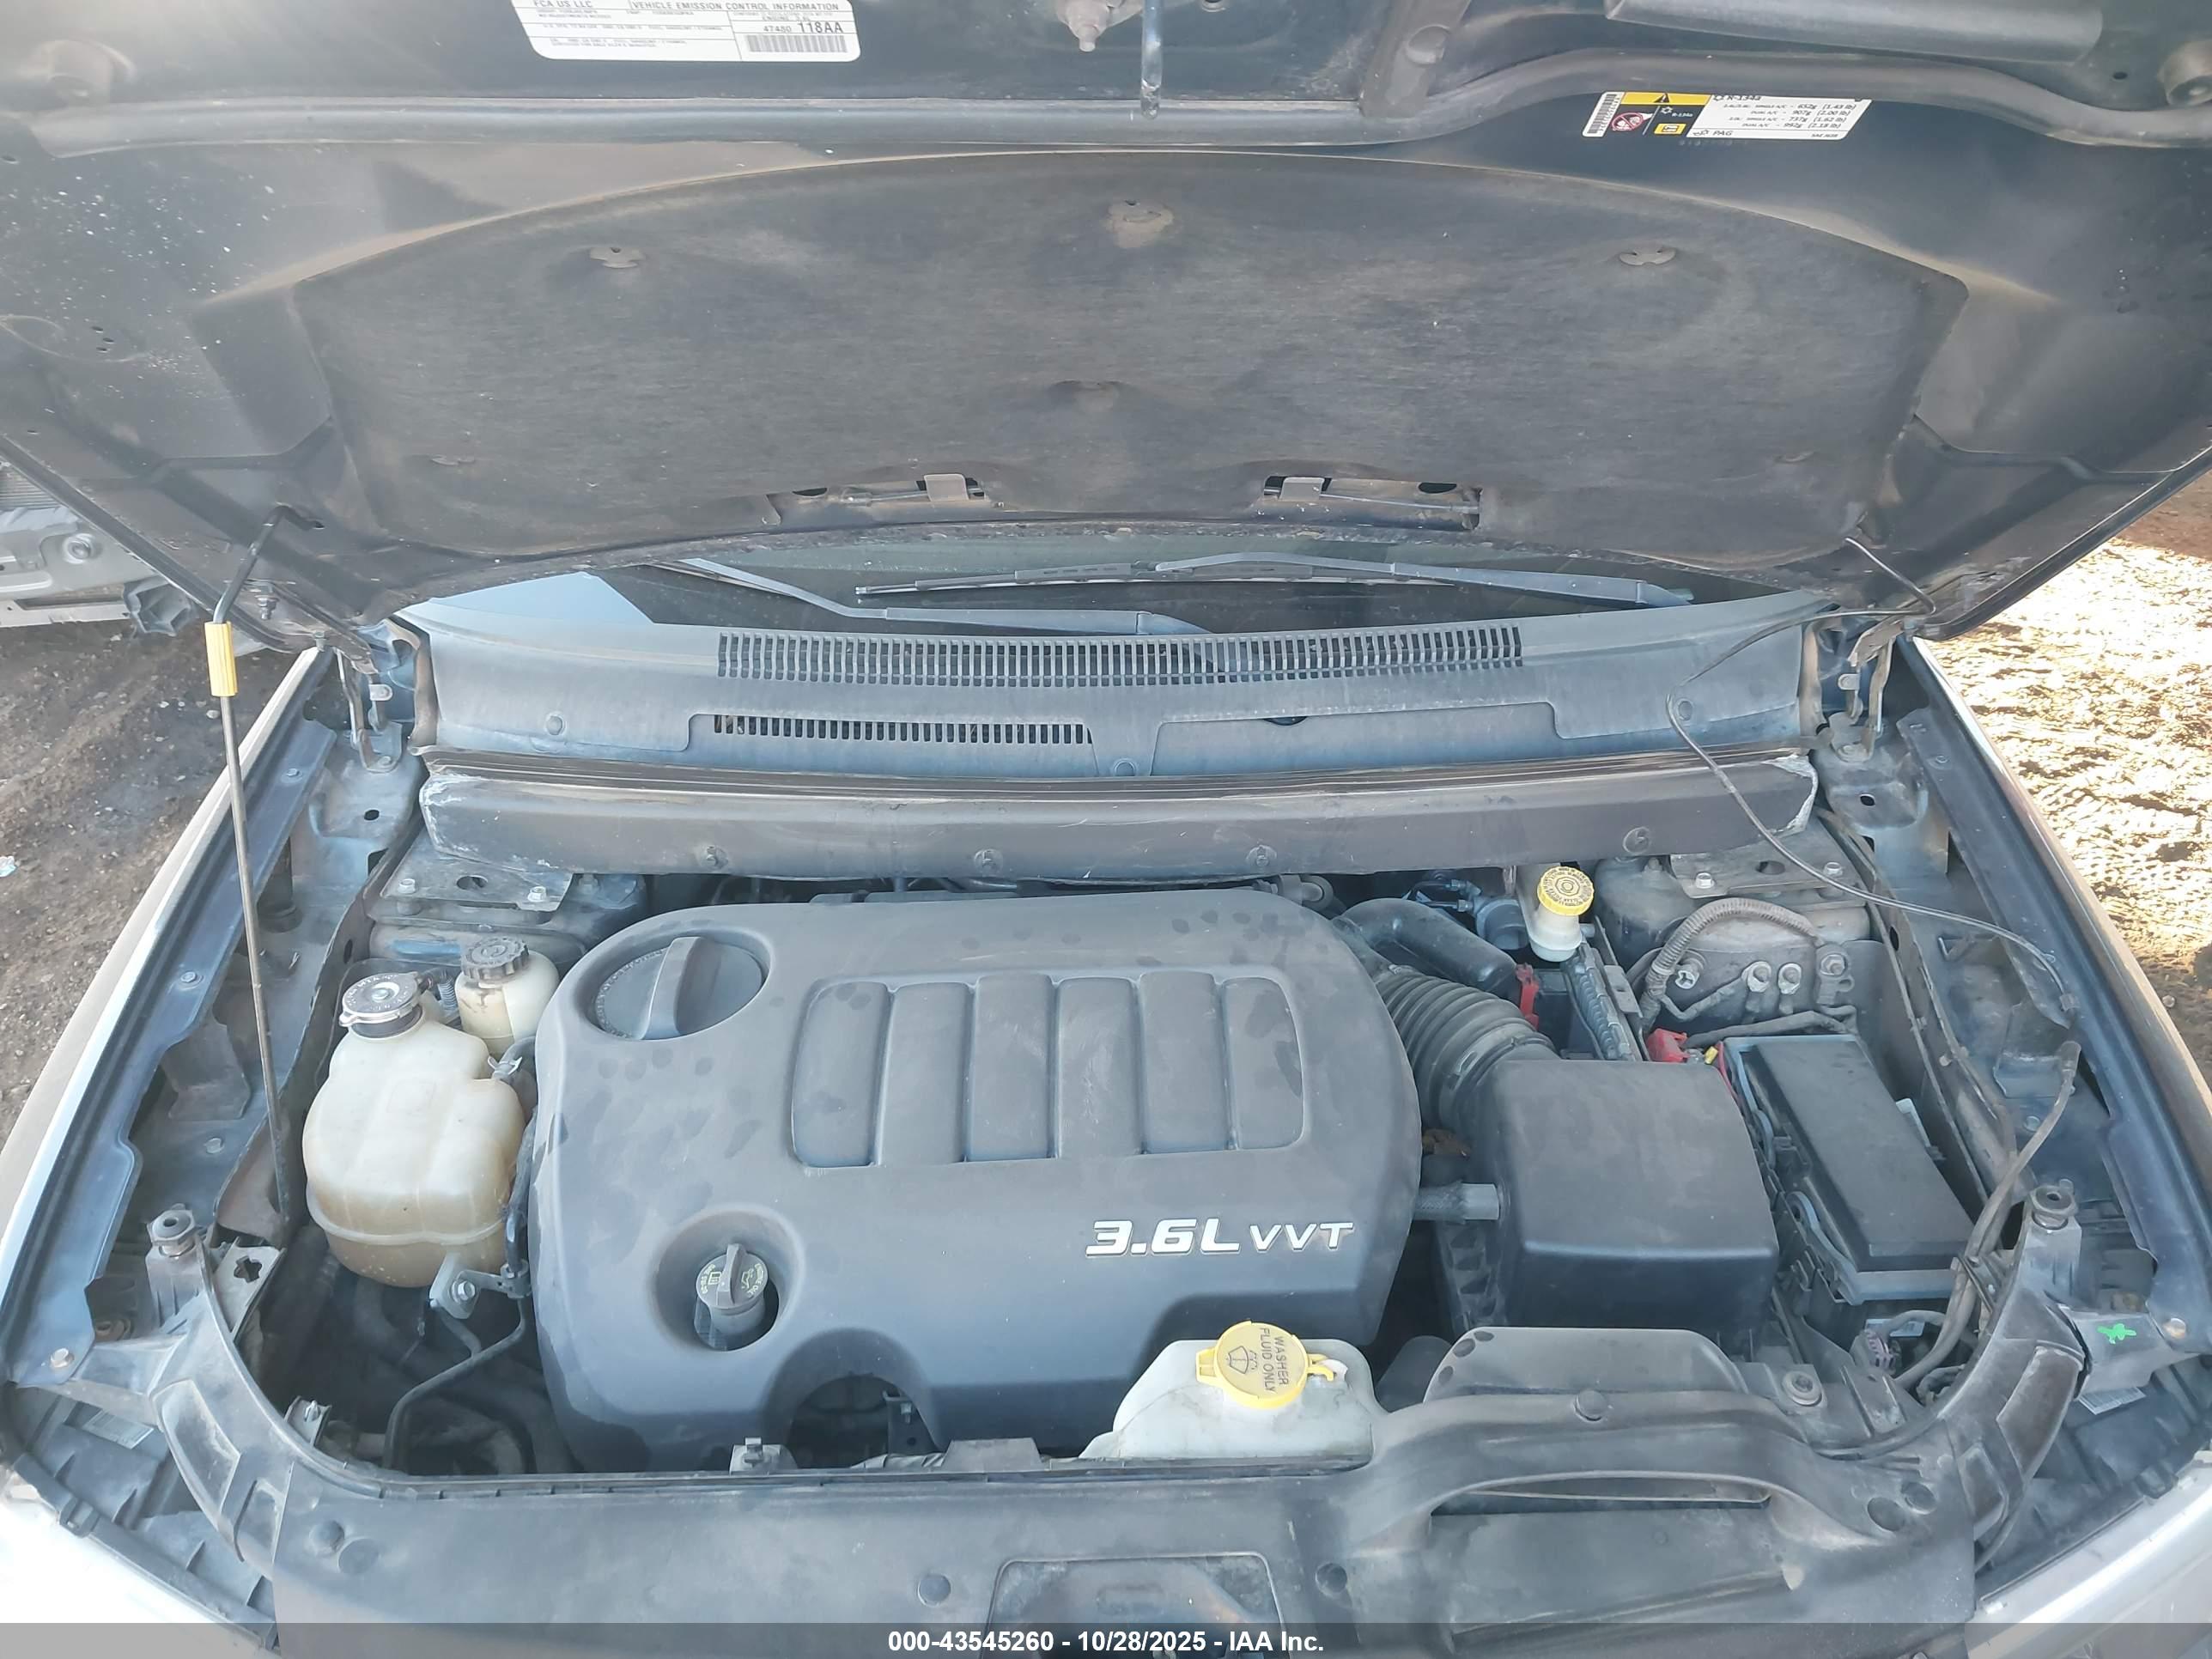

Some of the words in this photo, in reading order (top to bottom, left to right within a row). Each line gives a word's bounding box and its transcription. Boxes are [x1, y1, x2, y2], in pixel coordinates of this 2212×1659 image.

[798, 21, 843, 33] 118AA
[1085, 1218, 1240, 1257] 3.6L
[1249, 1222, 1354, 1253] VVT
[1260, 1328, 1273, 1360] FLUID
[1274, 1336, 1290, 1385] WASHER
[1262, 1363, 1278, 1394] ONLY
